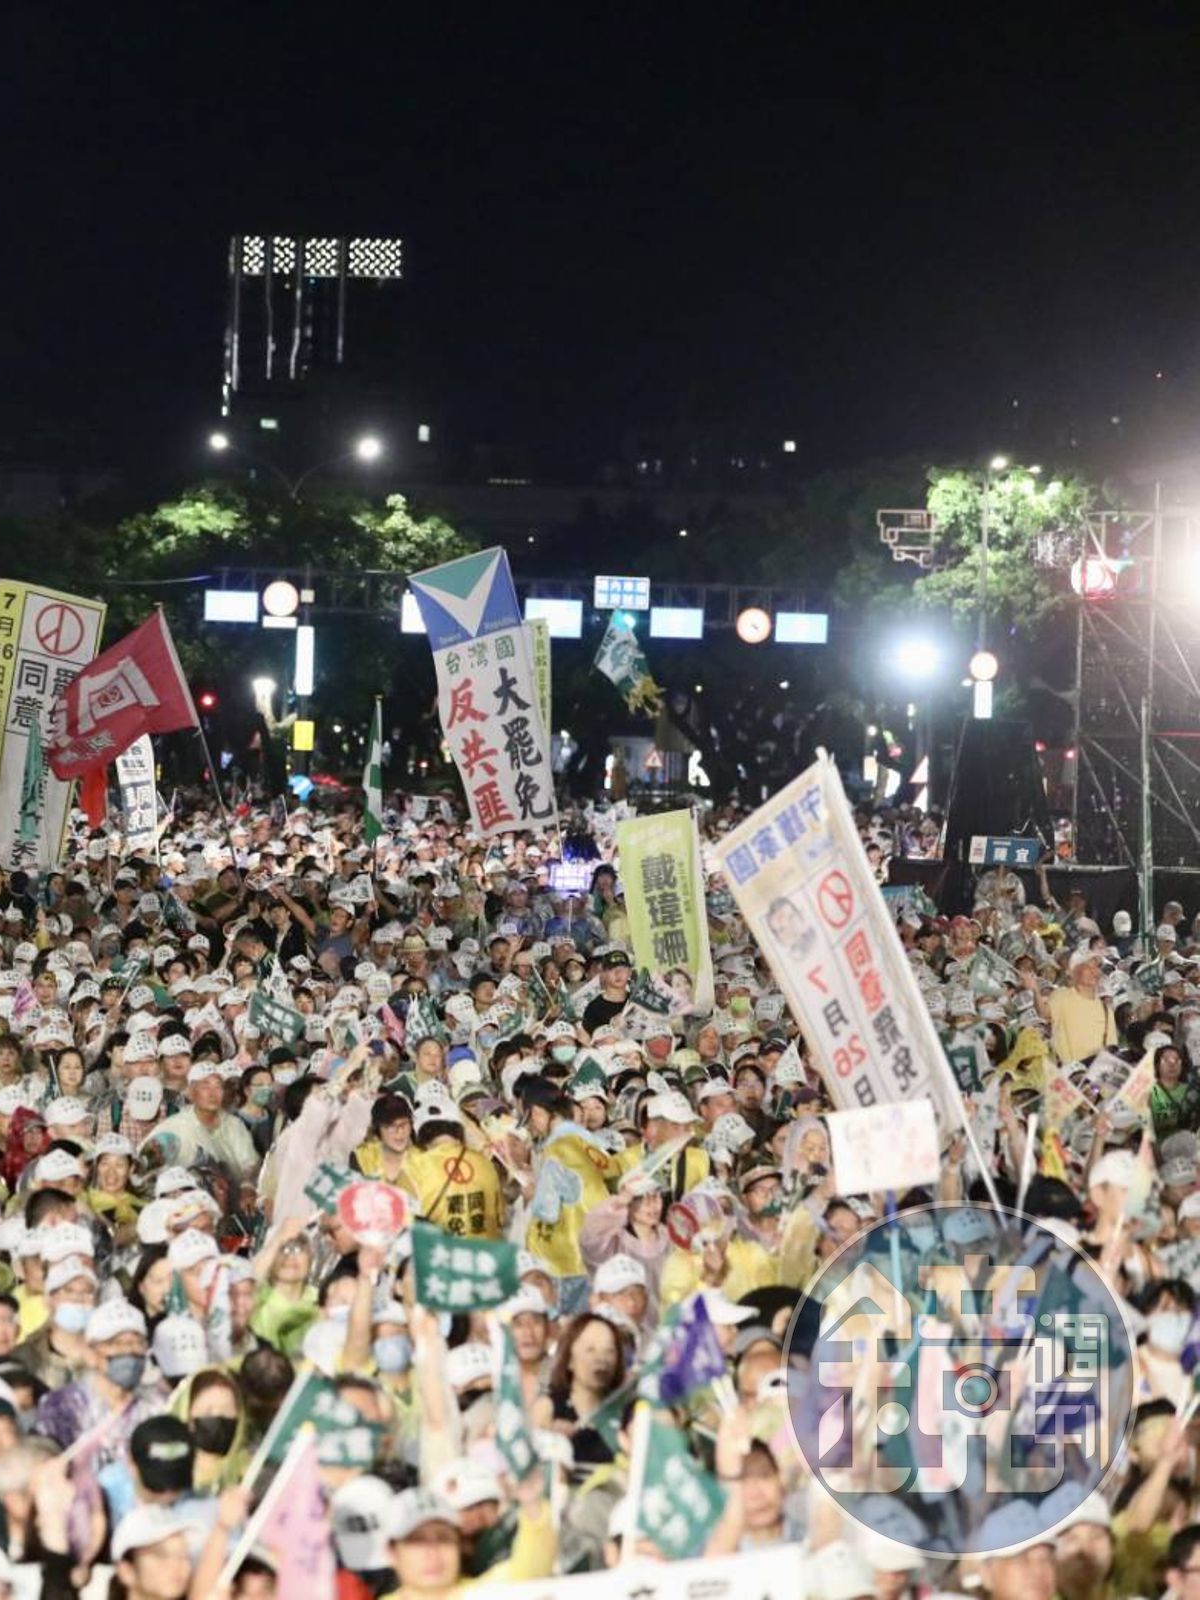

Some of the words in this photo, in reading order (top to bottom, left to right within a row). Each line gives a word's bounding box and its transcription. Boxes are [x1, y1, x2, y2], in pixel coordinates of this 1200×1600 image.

[10, 658, 48, 728] 同意
[445, 634, 516, 675] 台灣國
[447, 677, 514, 831] 反共匪
[493, 666, 553, 821] 大罷免
